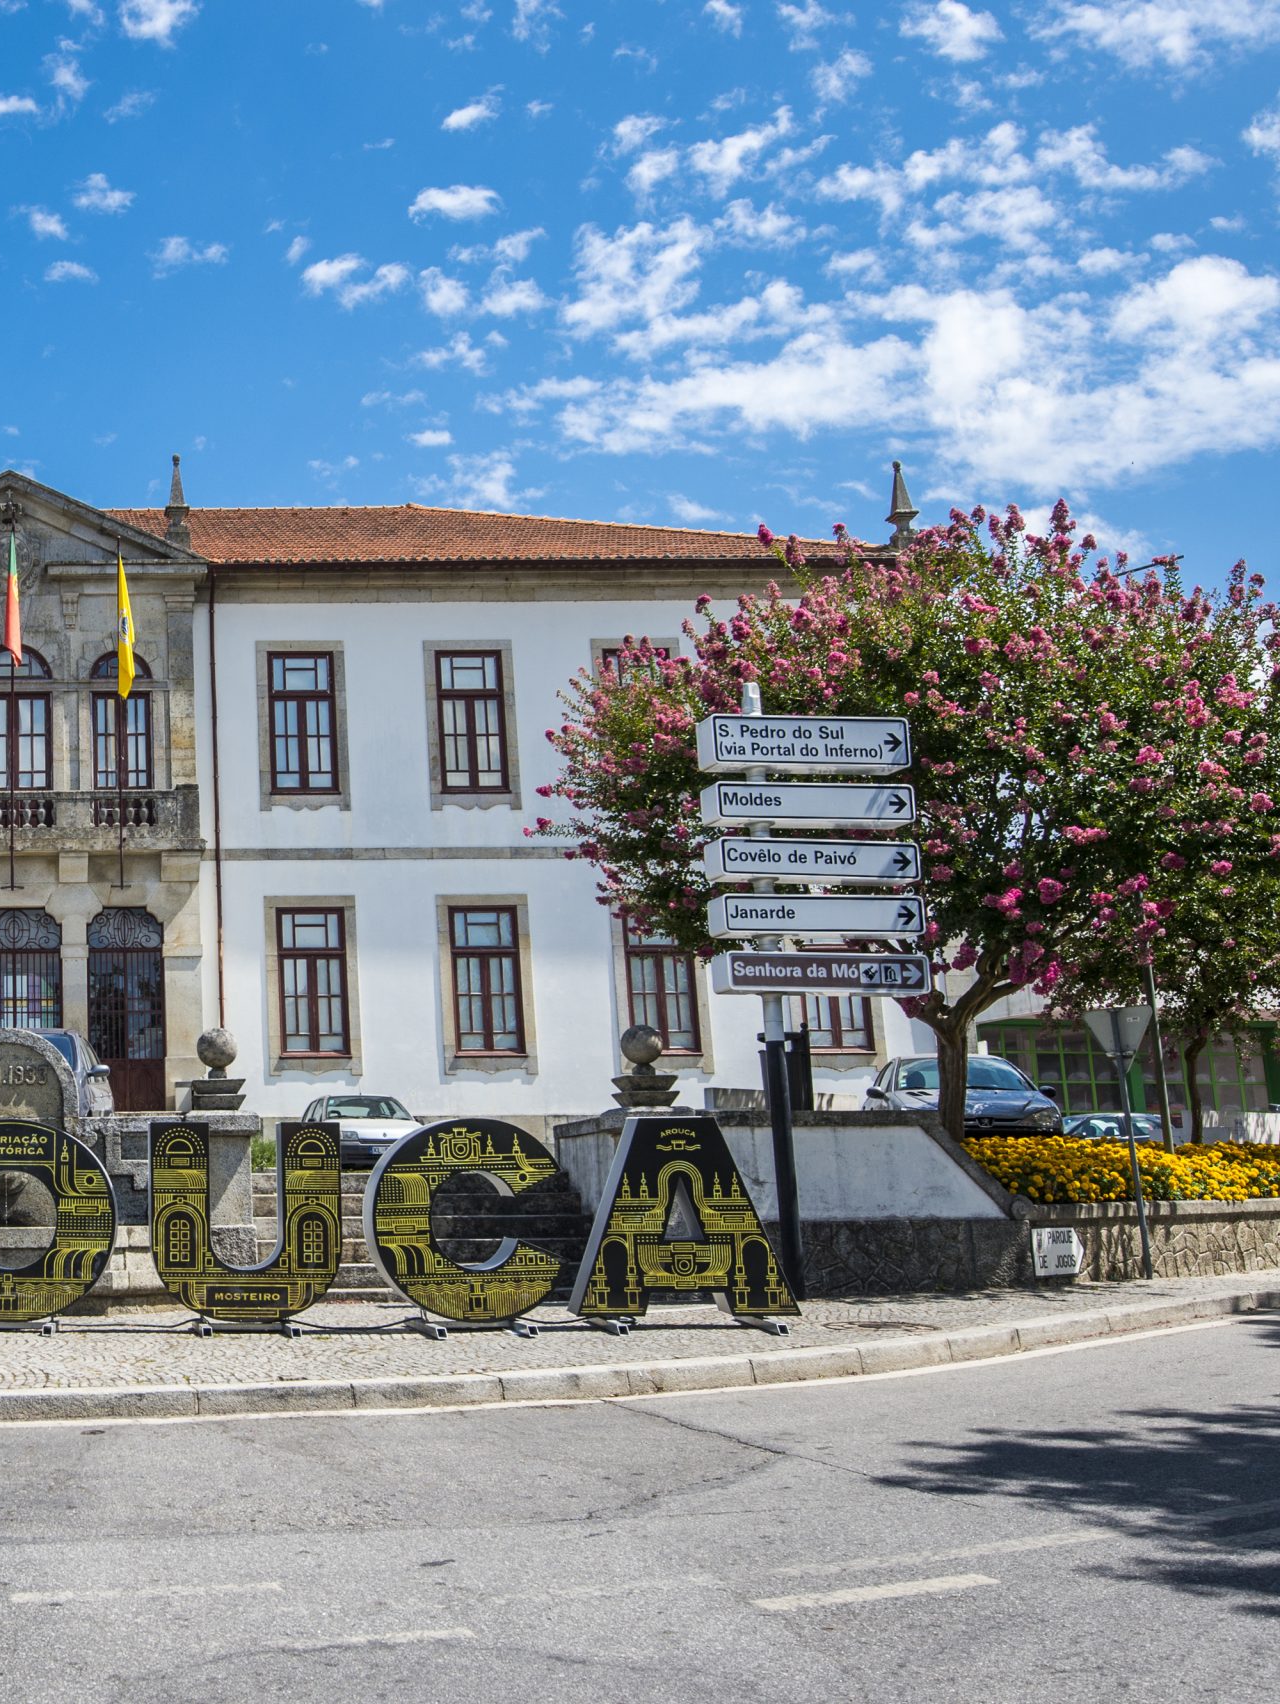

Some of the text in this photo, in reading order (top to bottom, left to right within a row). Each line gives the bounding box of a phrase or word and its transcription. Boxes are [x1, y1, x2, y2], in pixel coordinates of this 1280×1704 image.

[718, 724, 844, 740] S. Pedro do Sul
[719, 741, 883, 759] (via Portal do Inferno)
[722, 792, 782, 807] Moldes
[727, 847, 857, 865] Covêlo de Paivó
[730, 905, 796, 920] Janarde
[733, 961, 859, 978] Senhora da Mó
[660, 1128, 696, 1138] AROUCA
[1047, 1230, 1073, 1244] PARQUE
[1039, 1255, 1076, 1269] DE JOGOS
[214, 1292, 280, 1301] MOSTEIRO
